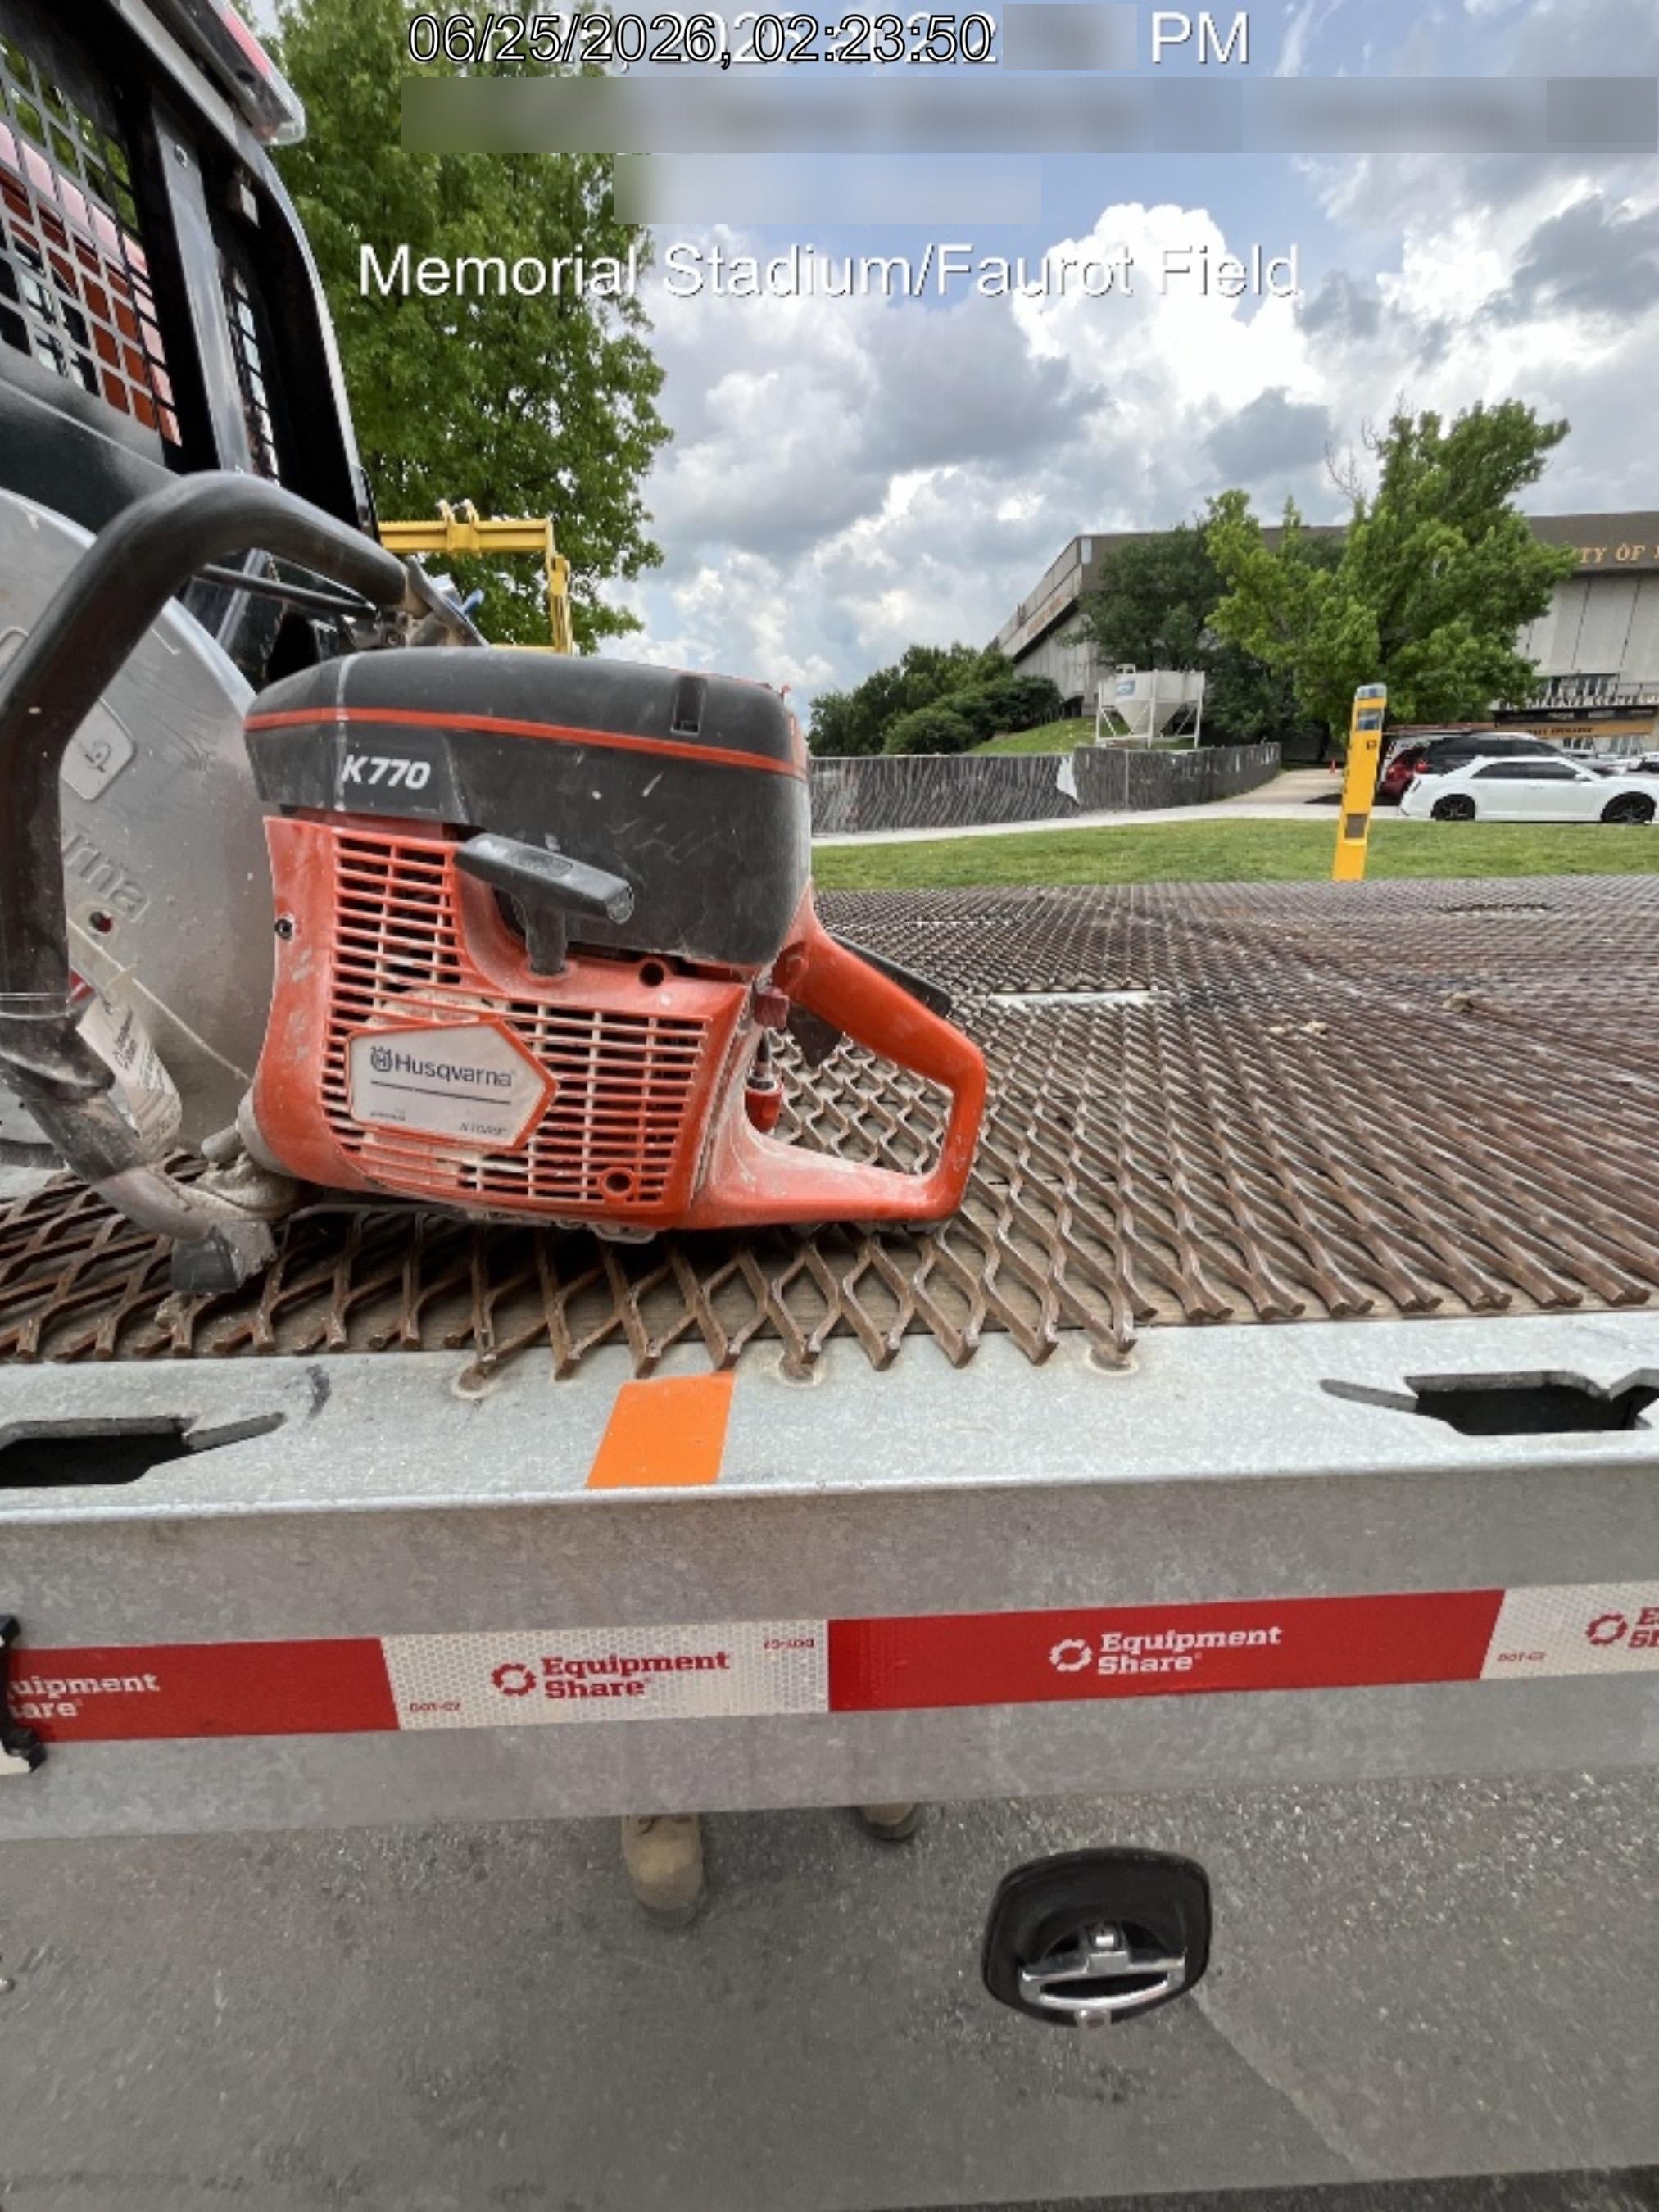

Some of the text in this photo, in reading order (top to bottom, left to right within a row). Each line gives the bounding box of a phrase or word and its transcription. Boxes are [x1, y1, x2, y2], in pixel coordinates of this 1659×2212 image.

[1616, 543, 1645, 562] OF
[341, 754, 431, 790] K770
[395, 1054, 512, 1087] Husqvarna
[1099, 1625, 1282, 1654] Equipment
[542, 1652, 730, 1679] Equipment
[1098, 1654, 1194, 1675] Share
[545, 1679, 645, 1699] Share
